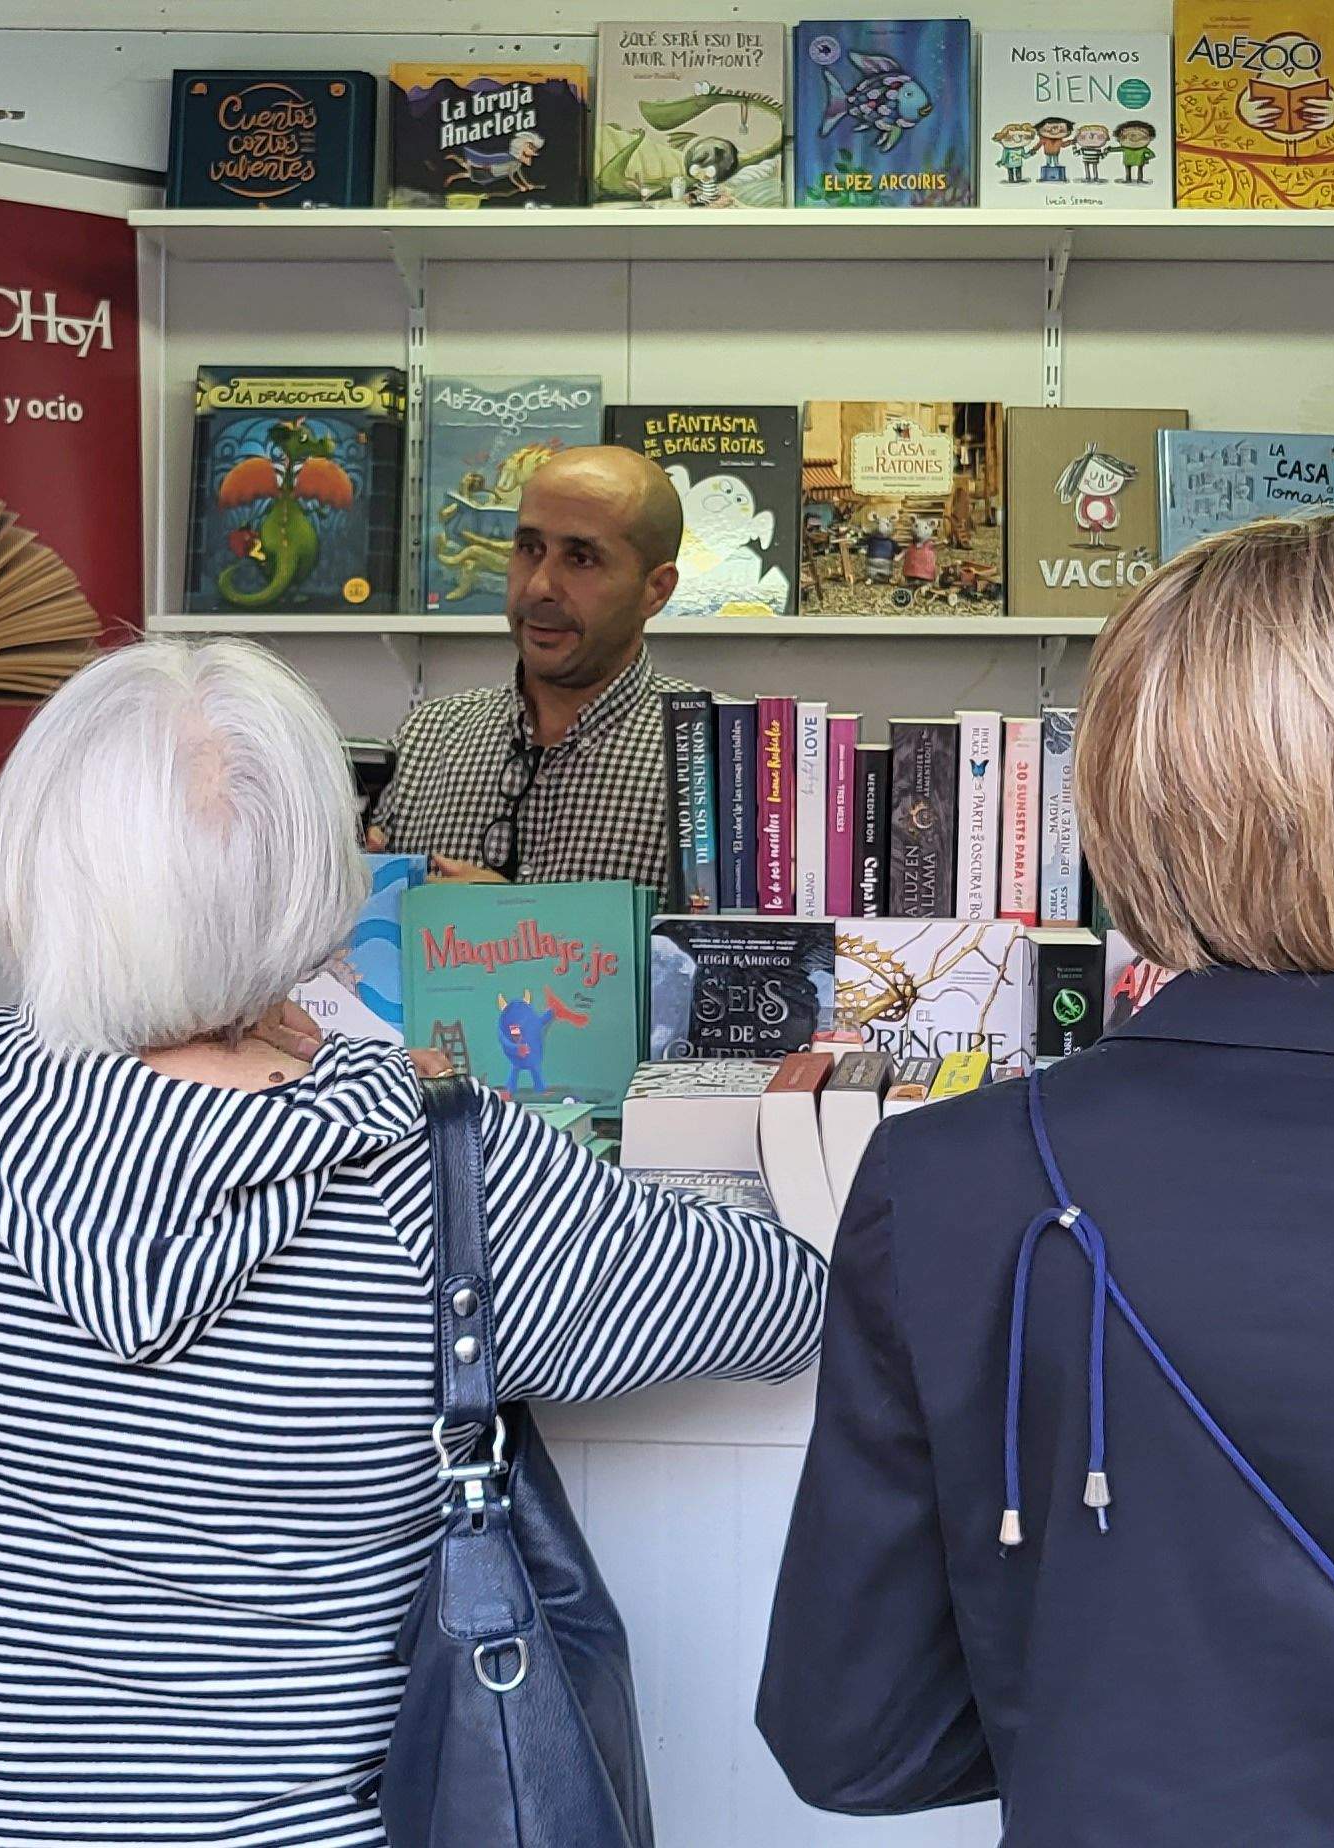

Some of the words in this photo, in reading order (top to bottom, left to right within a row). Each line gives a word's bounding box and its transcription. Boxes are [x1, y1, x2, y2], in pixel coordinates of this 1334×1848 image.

[661, 30, 699, 47] SERÁ
[736, 31, 764, 47] DEL
[218, 95, 317, 131] Cuentos
[440, 98, 467, 124] La
[471, 83, 535, 116] bruja
[228, 131, 299, 155] cortos
[440, 109, 538, 151] Anacleta
[210, 154, 316, 182] valientes
[823, 174, 844, 191] EL
[845, 173, 874, 191] PEZ
[877, 172, 948, 191] ARCOÍRIS
[5, 393, 22, 424] y
[27, 393, 85, 423] ocio
[234, 390, 253, 405] LA
[646, 420, 666, 436] EL
[667, 412, 759, 434] FANTASMA
[719, 437, 766, 454] ROTAS
[887, 442, 925, 458] CASA
[1268, 444, 1286, 459] LA
[875, 456, 944, 474] RATONES
[1276, 460, 1330, 484] CASA
[1038, 549, 1155, 589] VACÍO
[675, 721, 690, 783] PUERTA
[804, 716, 818, 758] LOVE
[691, 721, 708, 806] SUSURROS
[1016, 761, 1029, 781] 30
[866, 773, 876, 819] MERCEDES
[971, 792, 985, 833] PARTE
[1015, 782, 1028, 843] SUNSETS
[678, 810, 694, 849] BAJO
[693, 809, 709, 839] LOS
[863, 856, 879, 901] Culpa
[921, 852, 937, 908] LLAMA
[970, 843, 983, 890] OSCURA
[1013, 844, 1026, 881] PARA
[804, 872, 816, 907] HUANG
[905, 871, 920, 906] LUZ
[695, 977, 790, 1025] SEIS
[729, 1025, 757, 1043] DE
